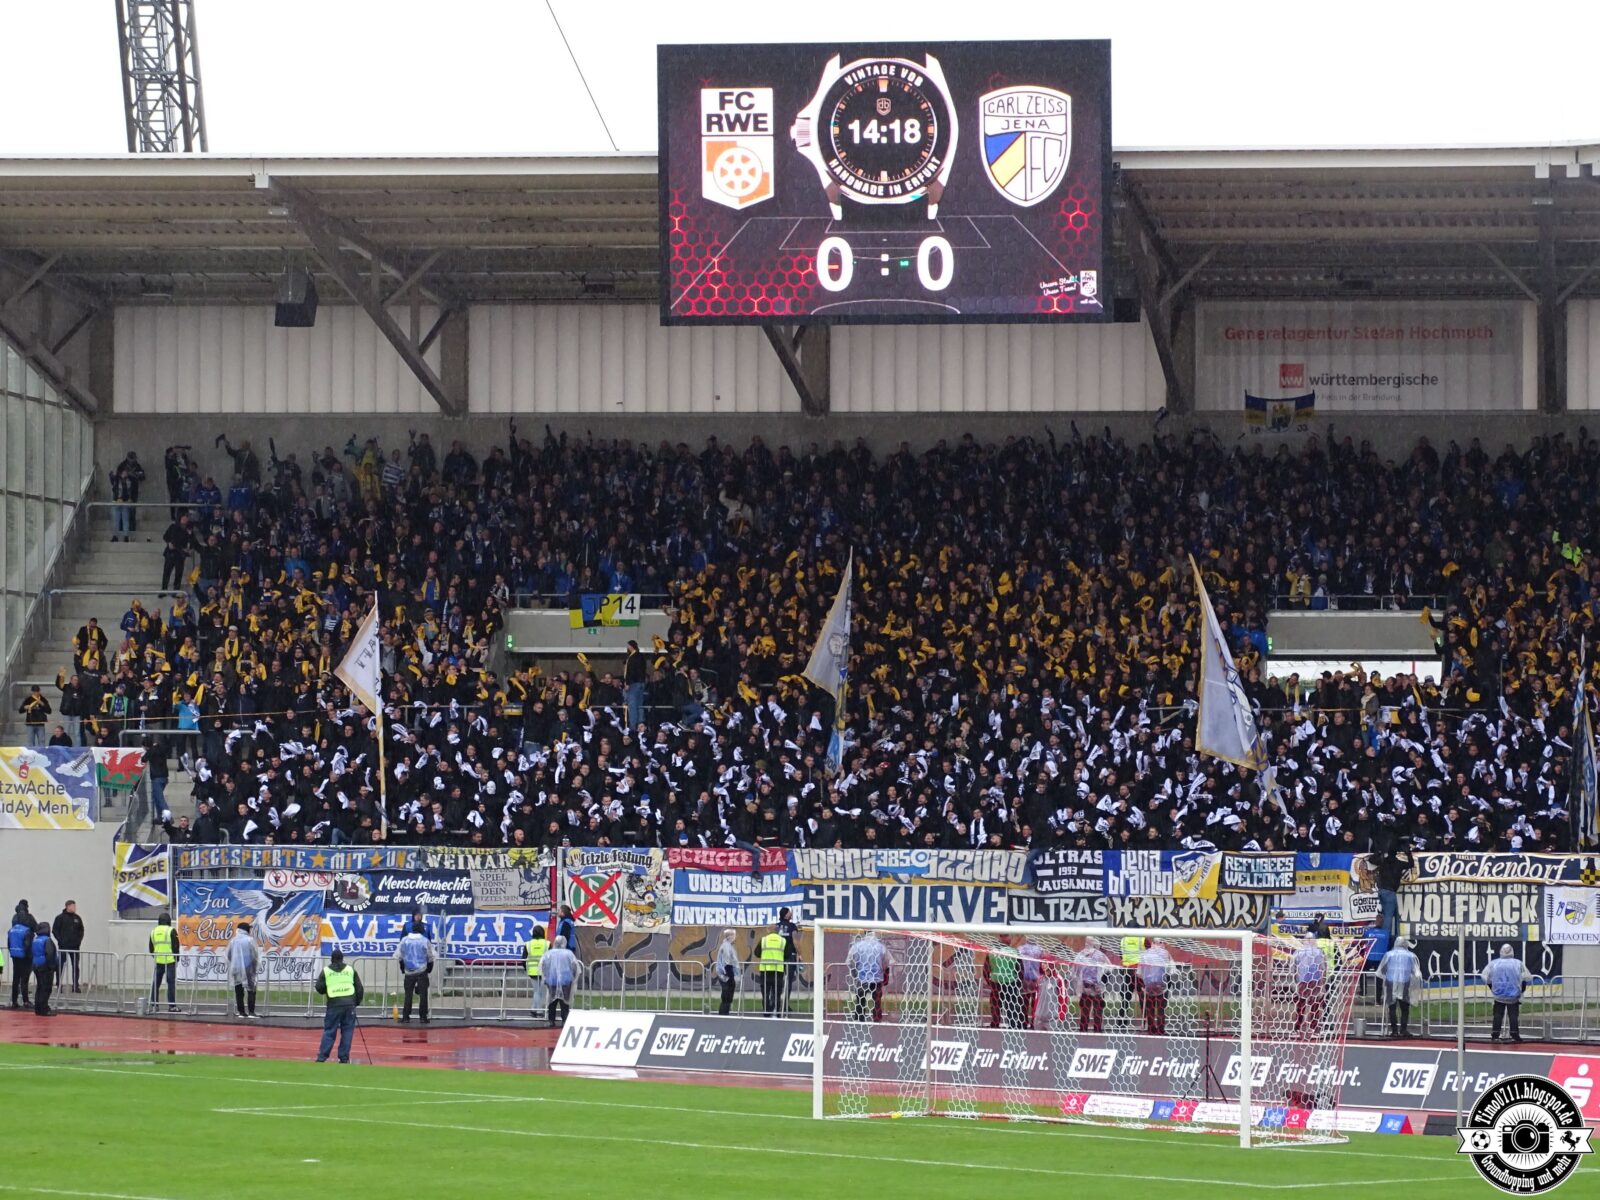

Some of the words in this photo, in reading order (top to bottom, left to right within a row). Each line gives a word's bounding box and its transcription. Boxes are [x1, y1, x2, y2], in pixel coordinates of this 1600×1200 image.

[844, 64, 896, 86] VINTAGE
[719, 91, 755, 111] FC
[988, 96, 1026, 115] CARL
[1026, 96, 1063, 115] ZEISS
[706, 113, 768, 132] RWE
[848, 118, 921, 145] 14:18
[1001, 119, 1050, 131] JENA
[1030, 136, 1063, 193] FC
[829, 158, 884, 196] HANDMADE
[889, 184, 902, 195] IN
[905, 156, 941, 191] ERFURT
[816, 236, 854, 292] 0
[917, 235, 954, 291] 0
[1225, 326, 1349, 343] Generalagentur
[1356, 326, 1405, 340] Stefan
[1410, 326, 1493, 340] Hochmuth
[1308, 372, 1439, 389] württembergische
[38, 800, 69, 814] Men
[180, 848, 306, 869] AUSGESPERRTE
[330, 852, 366, 870] MIT
[386, 850, 417, 869] UNS
[426, 852, 513, 870] WEIMAR
[610, 849, 653, 869] Festung
[1225, 856, 1294, 872] REFUGEES
[1425, 853, 1569, 884] Rockendorf
[479, 873, 507, 882] SPIEL
[1058, 866, 1078, 876] 1993
[1225, 872, 1293, 888] WELCOME
[378, 874, 472, 891] Menschenrechte
[481, 887, 507, 895] DEIN
[688, 873, 786, 894] UNBEUGSAM
[1037, 878, 1104, 892] LAUSANNE
[194, 886, 230, 914] Fan
[375, 893, 390, 904] aus
[393, 892, 411, 904] dem
[414, 891, 449, 905] Abseits
[450, 893, 472, 905] holen
[802, 884, 1007, 923] SÜDKURVE
[1396, 893, 1538, 923] WOLFPACK
[1012, 897, 1108, 921] ULTRAS
[193, 918, 233, 942] Club
[329, 916, 535, 943] WEMAR
[1415, 924, 1438, 936] FCC
[1551, 932, 1600, 942] CHAOTEN
[333, 940, 361, 954] ist
[562, 1025, 643, 1050] NT.AG
[656, 1032, 689, 1051] SWE
[695, 1034, 722, 1054] Für
[720, 1034, 766, 1056] Erfurt.
[788, 1038, 815, 1057] SW
[830, 1041, 852, 1061] Für
[851, 1041, 904, 1063] Erfurt.
[930, 1045, 964, 1066] SWE
[972, 1048, 999, 1069] Für
[1000, 1050, 1049, 1071] Erfurt.
[1075, 1053, 1111, 1074] SWE
[1121, 1056, 1148, 1075] Für
[1228, 1060, 1265, 1081] SE
[1276, 1063, 1302, 1084] Für
[1307, 1064, 1362, 1088] Erfurt.
[1389, 1071, 1428, 1089] SWE
[1443, 1072, 1473, 1092] Für
